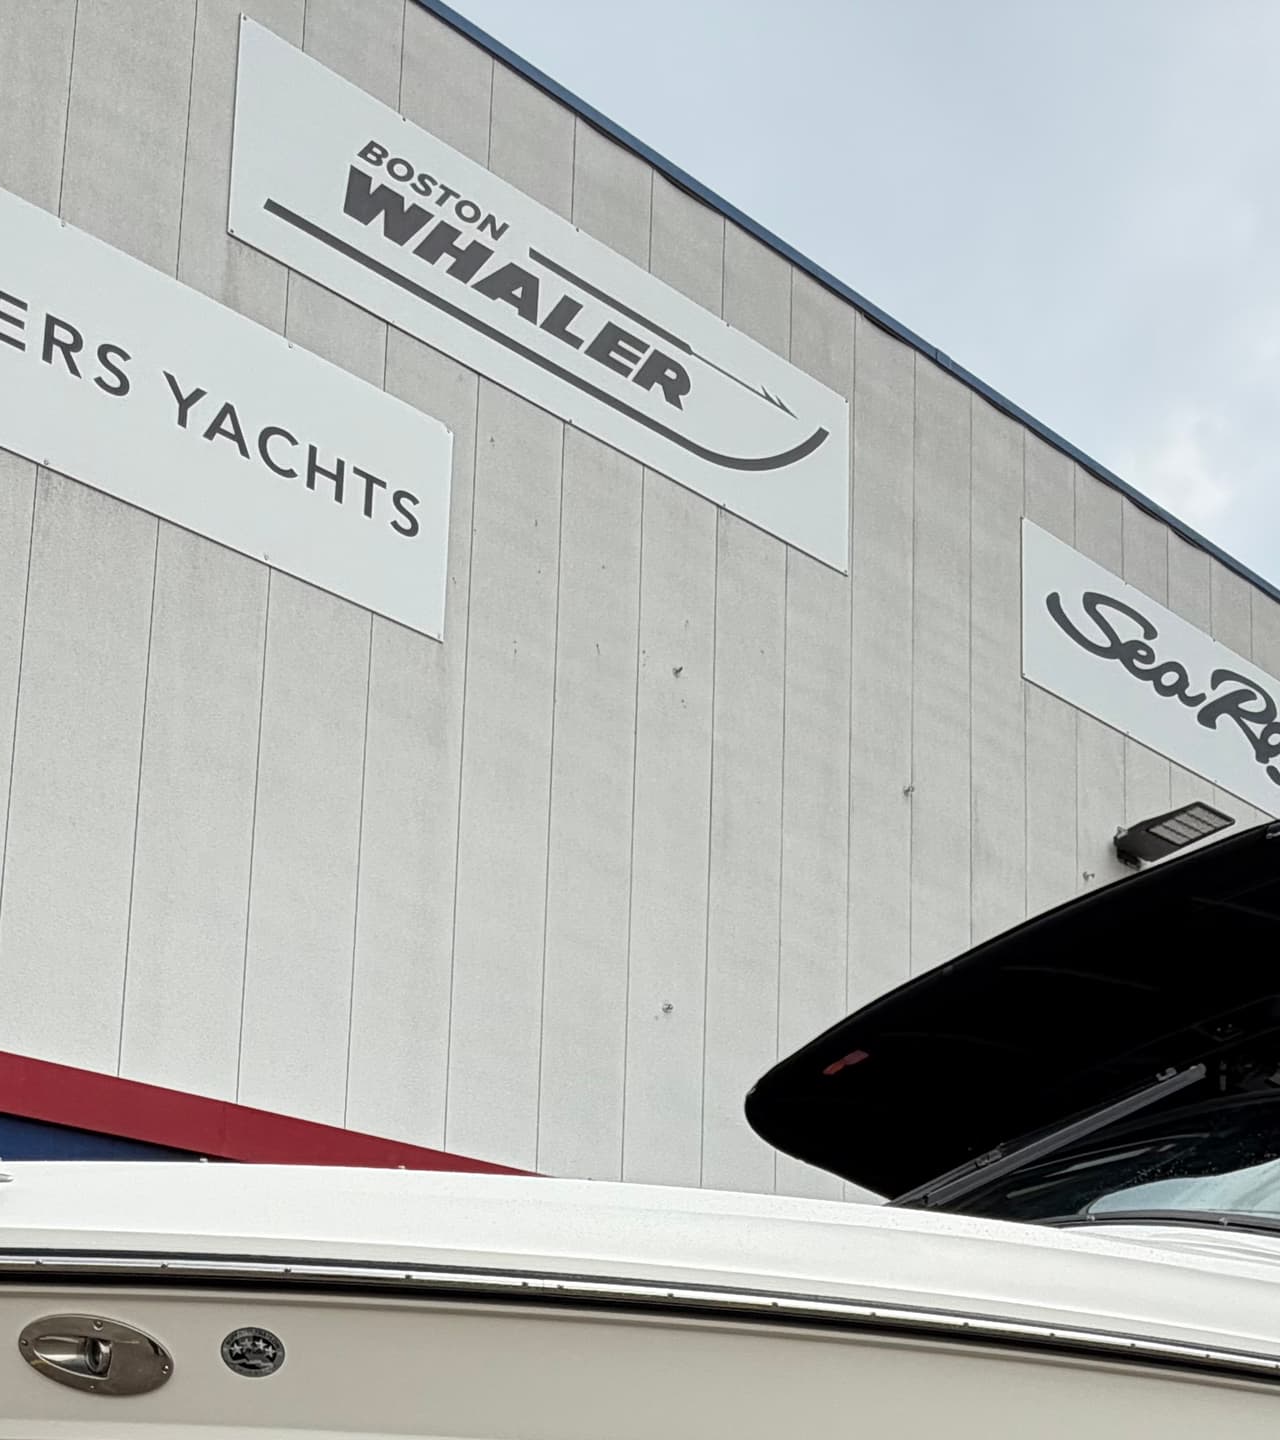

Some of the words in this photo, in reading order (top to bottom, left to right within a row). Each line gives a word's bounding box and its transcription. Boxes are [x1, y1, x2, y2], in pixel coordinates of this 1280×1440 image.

[357, 140, 510, 241] BOSTON
[343, 164, 691, 411] WHALER
[163, 371, 420, 537] YACHTS
[1045, 591, 1207, 708] Sea
